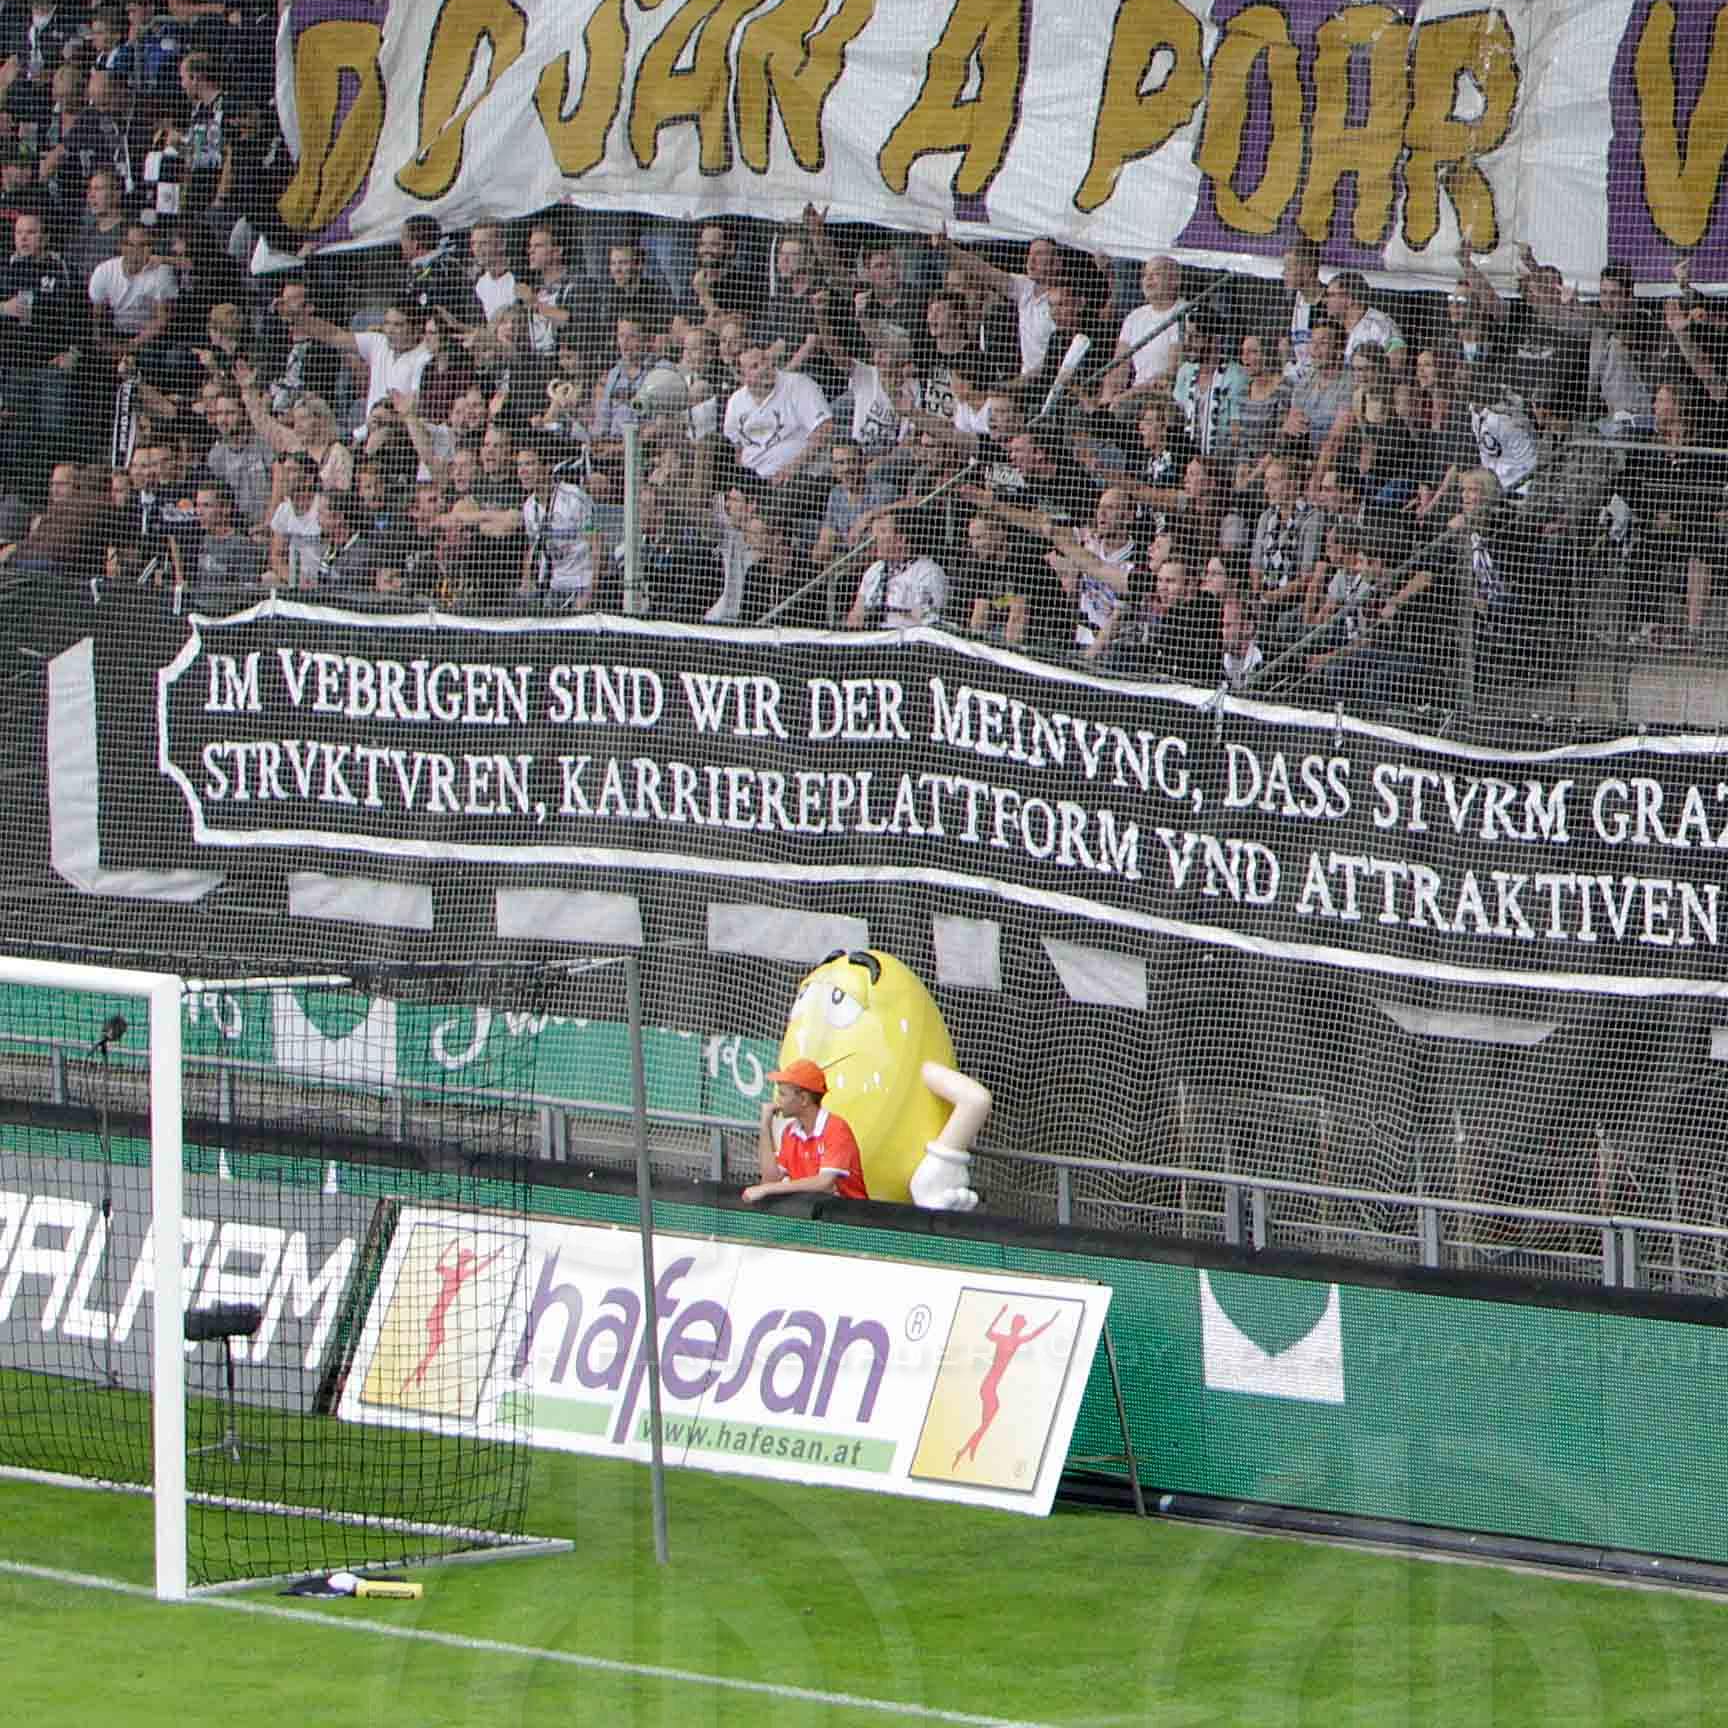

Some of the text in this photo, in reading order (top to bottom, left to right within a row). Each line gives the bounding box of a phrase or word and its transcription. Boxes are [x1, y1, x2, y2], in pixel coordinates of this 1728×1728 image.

[203, 741, 548, 824] STRVKTVREN,
[560, 758, 1143, 881] KARRIEREPLATTFORM
[1156, 827, 1281, 906] VND
[1296, 851, 1722, 948] ATTRAKTIVEN
[205, 652, 262, 714] IM
[279, 647, 531, 726] VEBRIGEN
[548, 665, 664, 729] SIND
[679, 674, 789, 740] WIR
[808, 679, 910, 743] DER
[929, 678, 1205, 814] MEINVNG,
[1224, 742, 1352, 820] DASS
[1373, 764, 1569, 844] STVRM
[511, 1244, 892, 1444] hafesan
